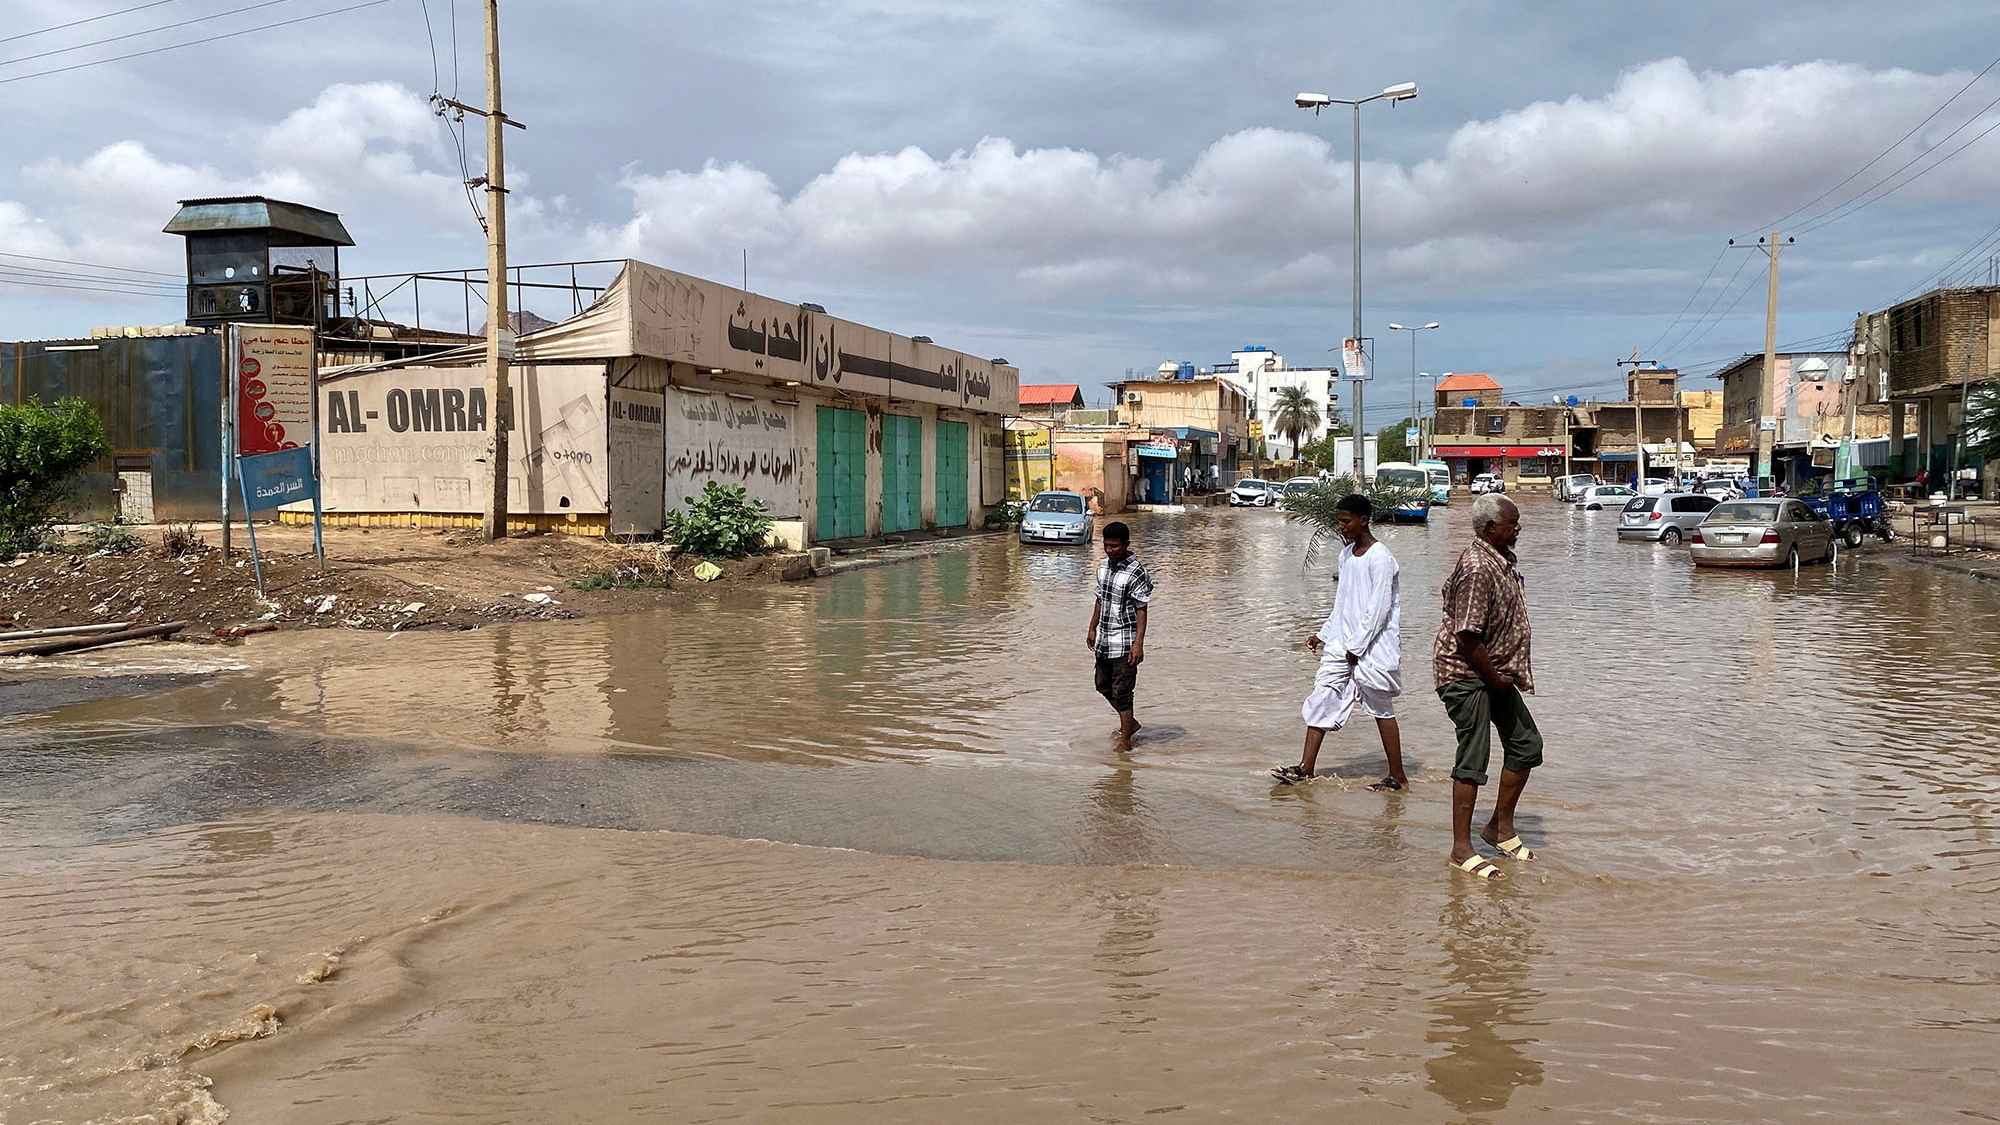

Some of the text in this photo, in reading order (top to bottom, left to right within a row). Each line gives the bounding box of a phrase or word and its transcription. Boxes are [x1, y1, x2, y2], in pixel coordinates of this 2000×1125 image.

[727, 299, 809, 369] الحديث
[963, 367, 991, 404] مجمع
[328, 387, 516, 433] AL- OMRA
[628, 403, 662, 425] OMRAN
[680, 397, 787, 432] مجمع العمران الحديث
[256, 481, 285, 498] العمدة
